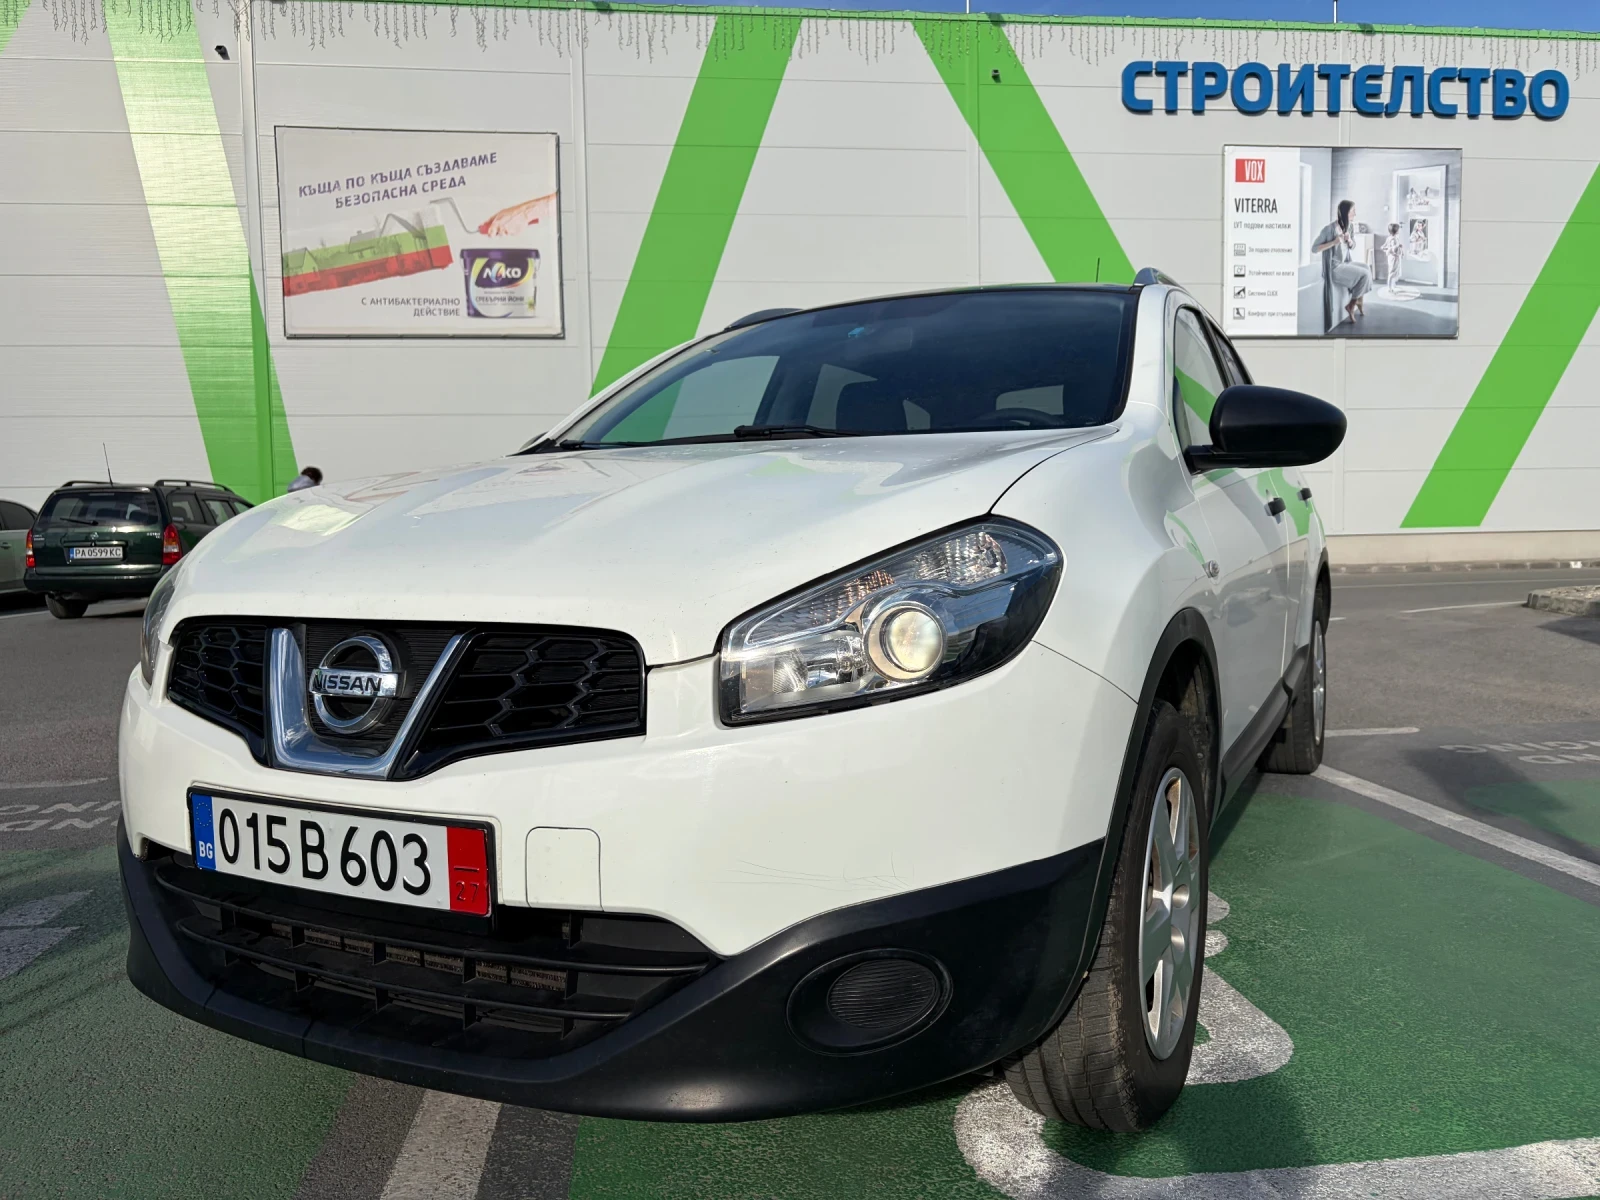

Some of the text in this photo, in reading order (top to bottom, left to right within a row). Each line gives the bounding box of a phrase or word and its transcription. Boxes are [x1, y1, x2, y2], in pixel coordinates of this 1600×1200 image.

[1121, 60, 1570, 119] СТРОИТЕЛСТВО
[298, 152, 497, 198] КЪЩА ПО КЪЩА СЪЗДАВАМЕ
[1244, 160, 1264, 181] VOX
[335, 175, 467, 209] БЕЗОПАСНА СРЕДА
[1234, 197, 1278, 214] VITERRA
[361, 297, 460, 306] С АНТИБАКТЕРИАЛНО
[413, 306, 460, 317] ДЕЙСТВИЕ
[313, 674, 383, 692] NISSAN
[199, 840, 214, 860] BG
[456, 880, 480, 903] 27
